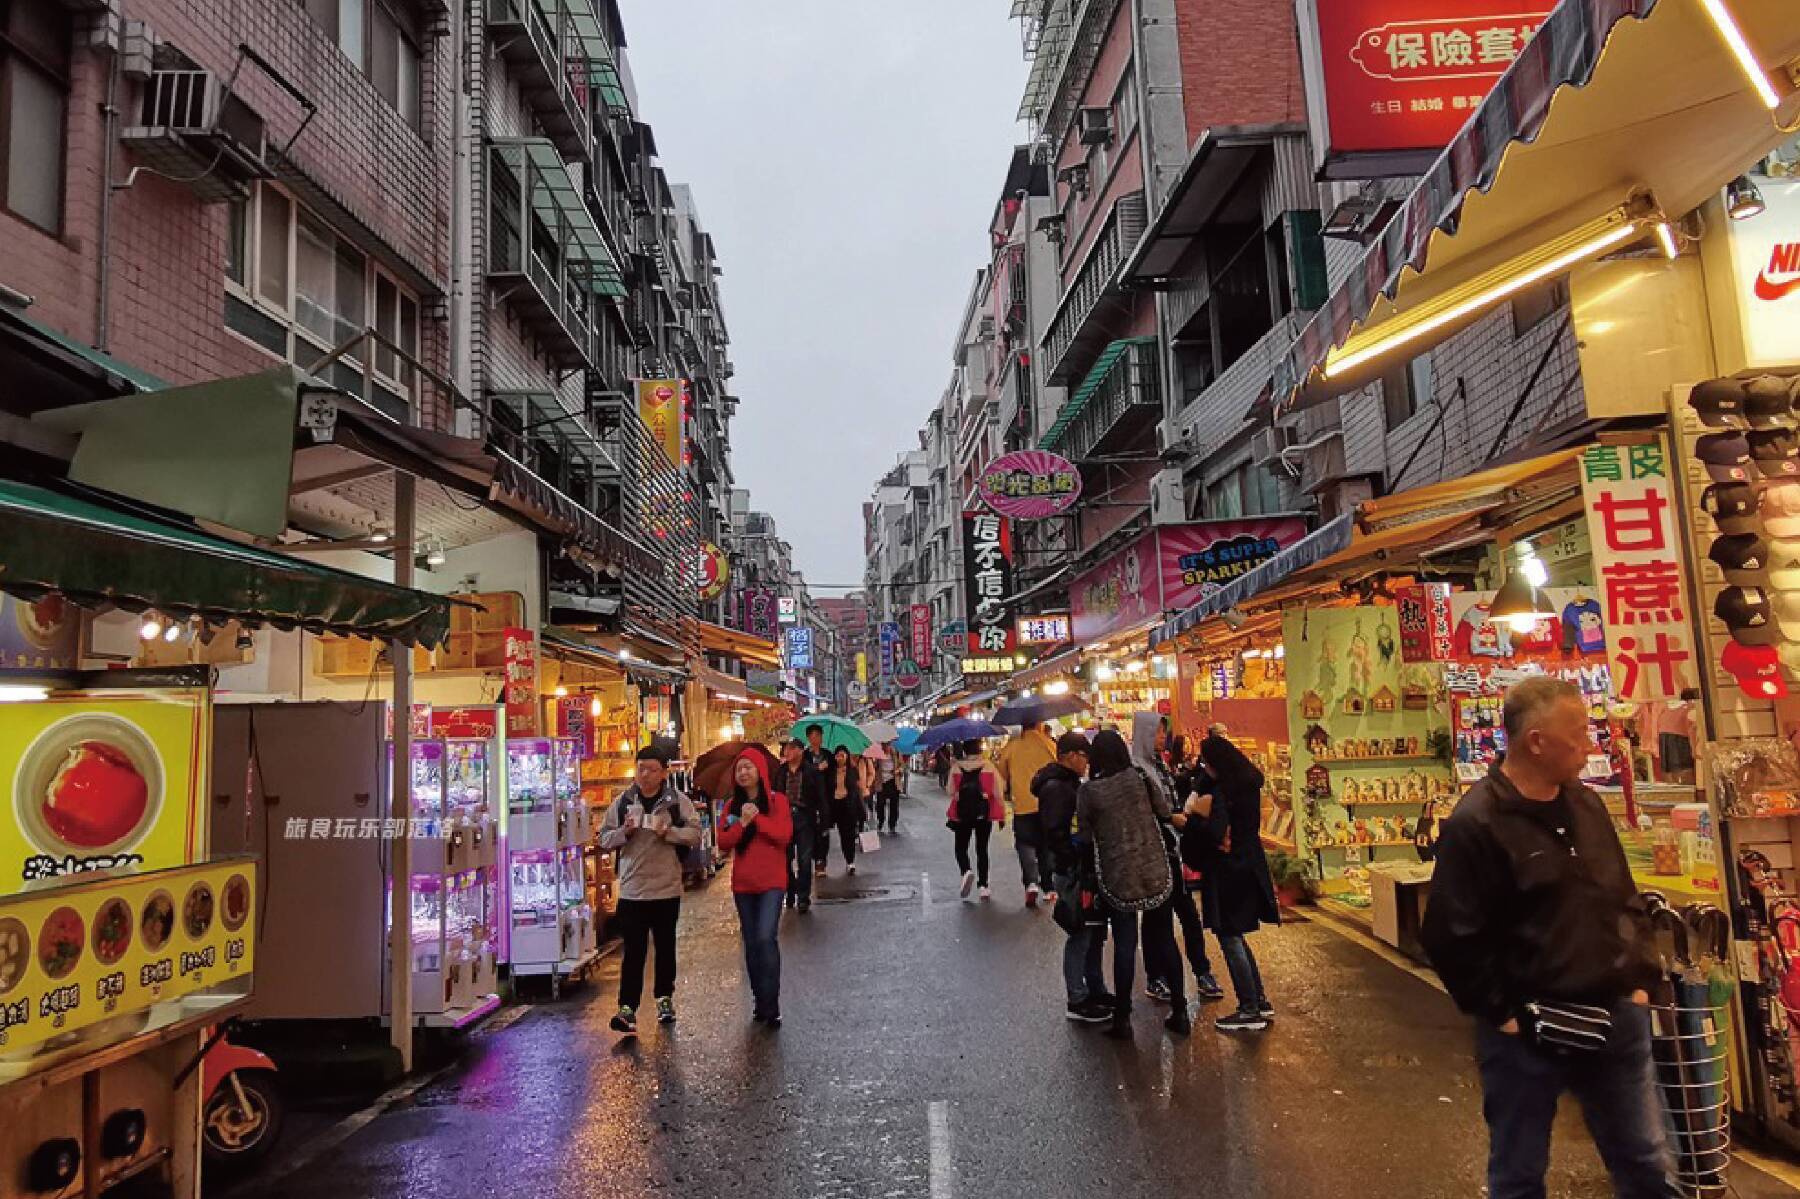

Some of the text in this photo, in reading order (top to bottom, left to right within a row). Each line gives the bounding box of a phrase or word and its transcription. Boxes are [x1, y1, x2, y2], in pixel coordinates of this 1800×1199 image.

[1371, 100, 1402, 114] 生日
[1768, 243, 1800, 273] NI
[1582, 443, 1667, 482] 青皮
[1179, 536, 1280, 570] IT'S SUPER
[1593, 488, 1689, 698] 甘蔗汁
